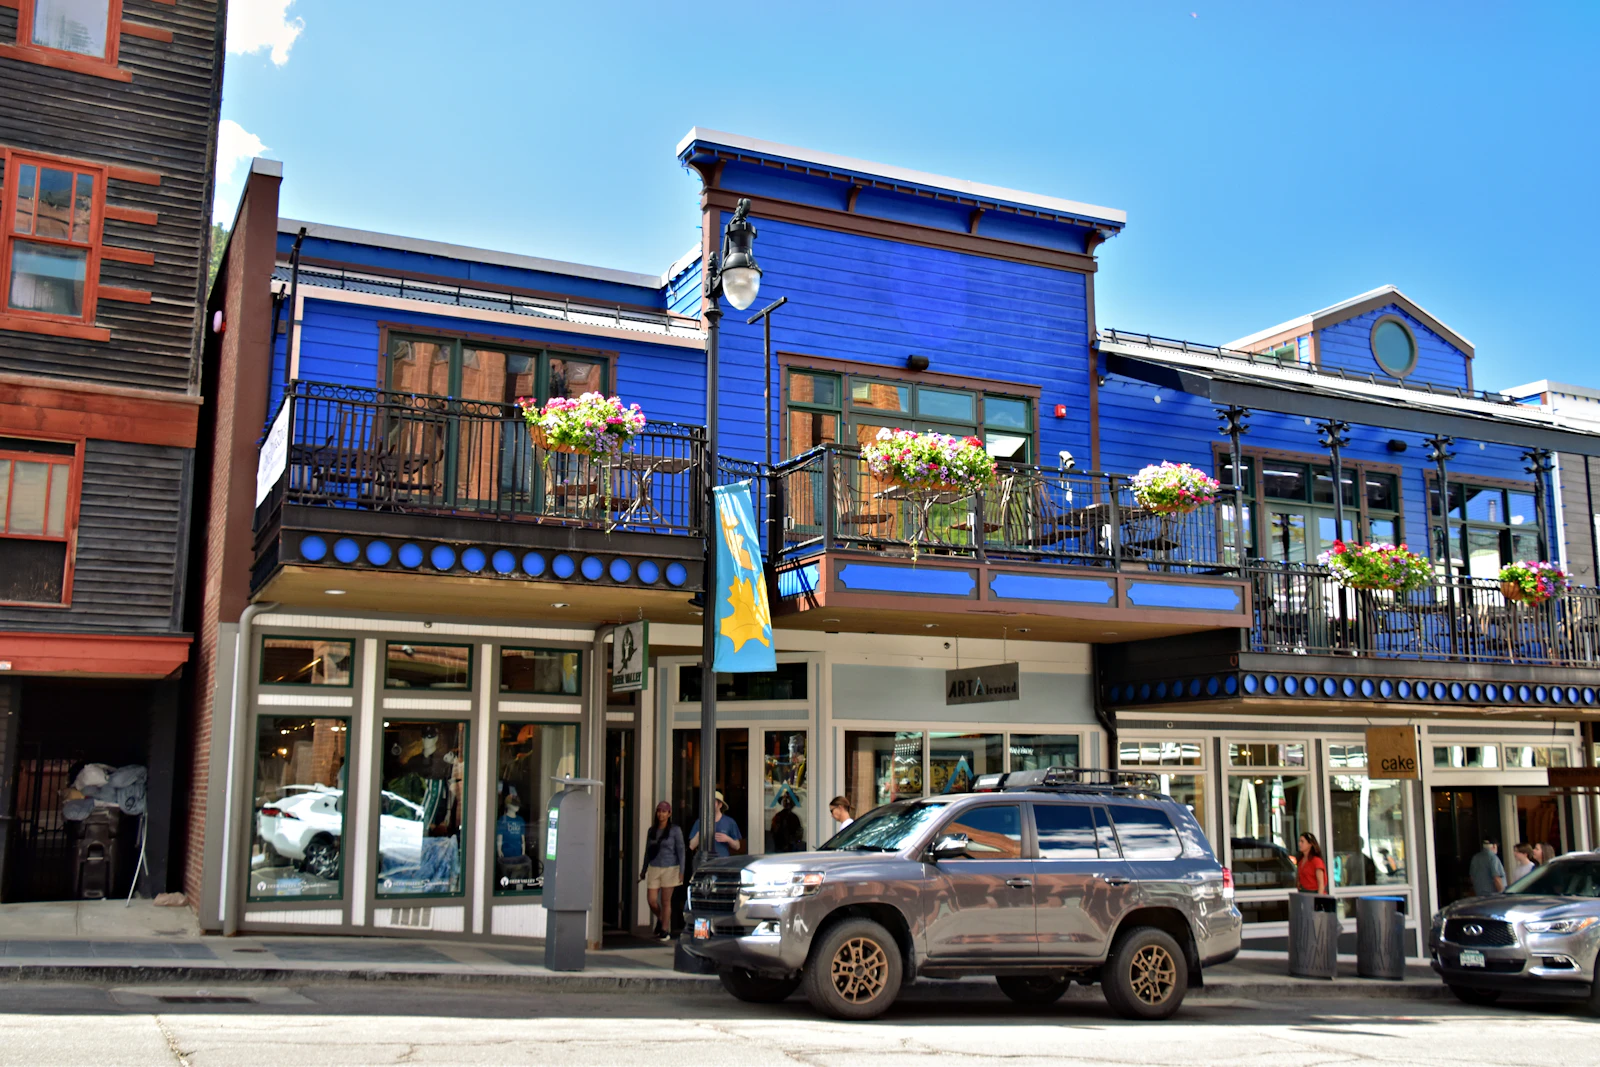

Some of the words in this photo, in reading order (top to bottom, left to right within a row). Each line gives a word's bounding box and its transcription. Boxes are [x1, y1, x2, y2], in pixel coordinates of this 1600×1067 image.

[625, 671, 642, 684] VALLEY
[948, 680, 973, 698] ART
[1381, 755, 1415, 771] cake
